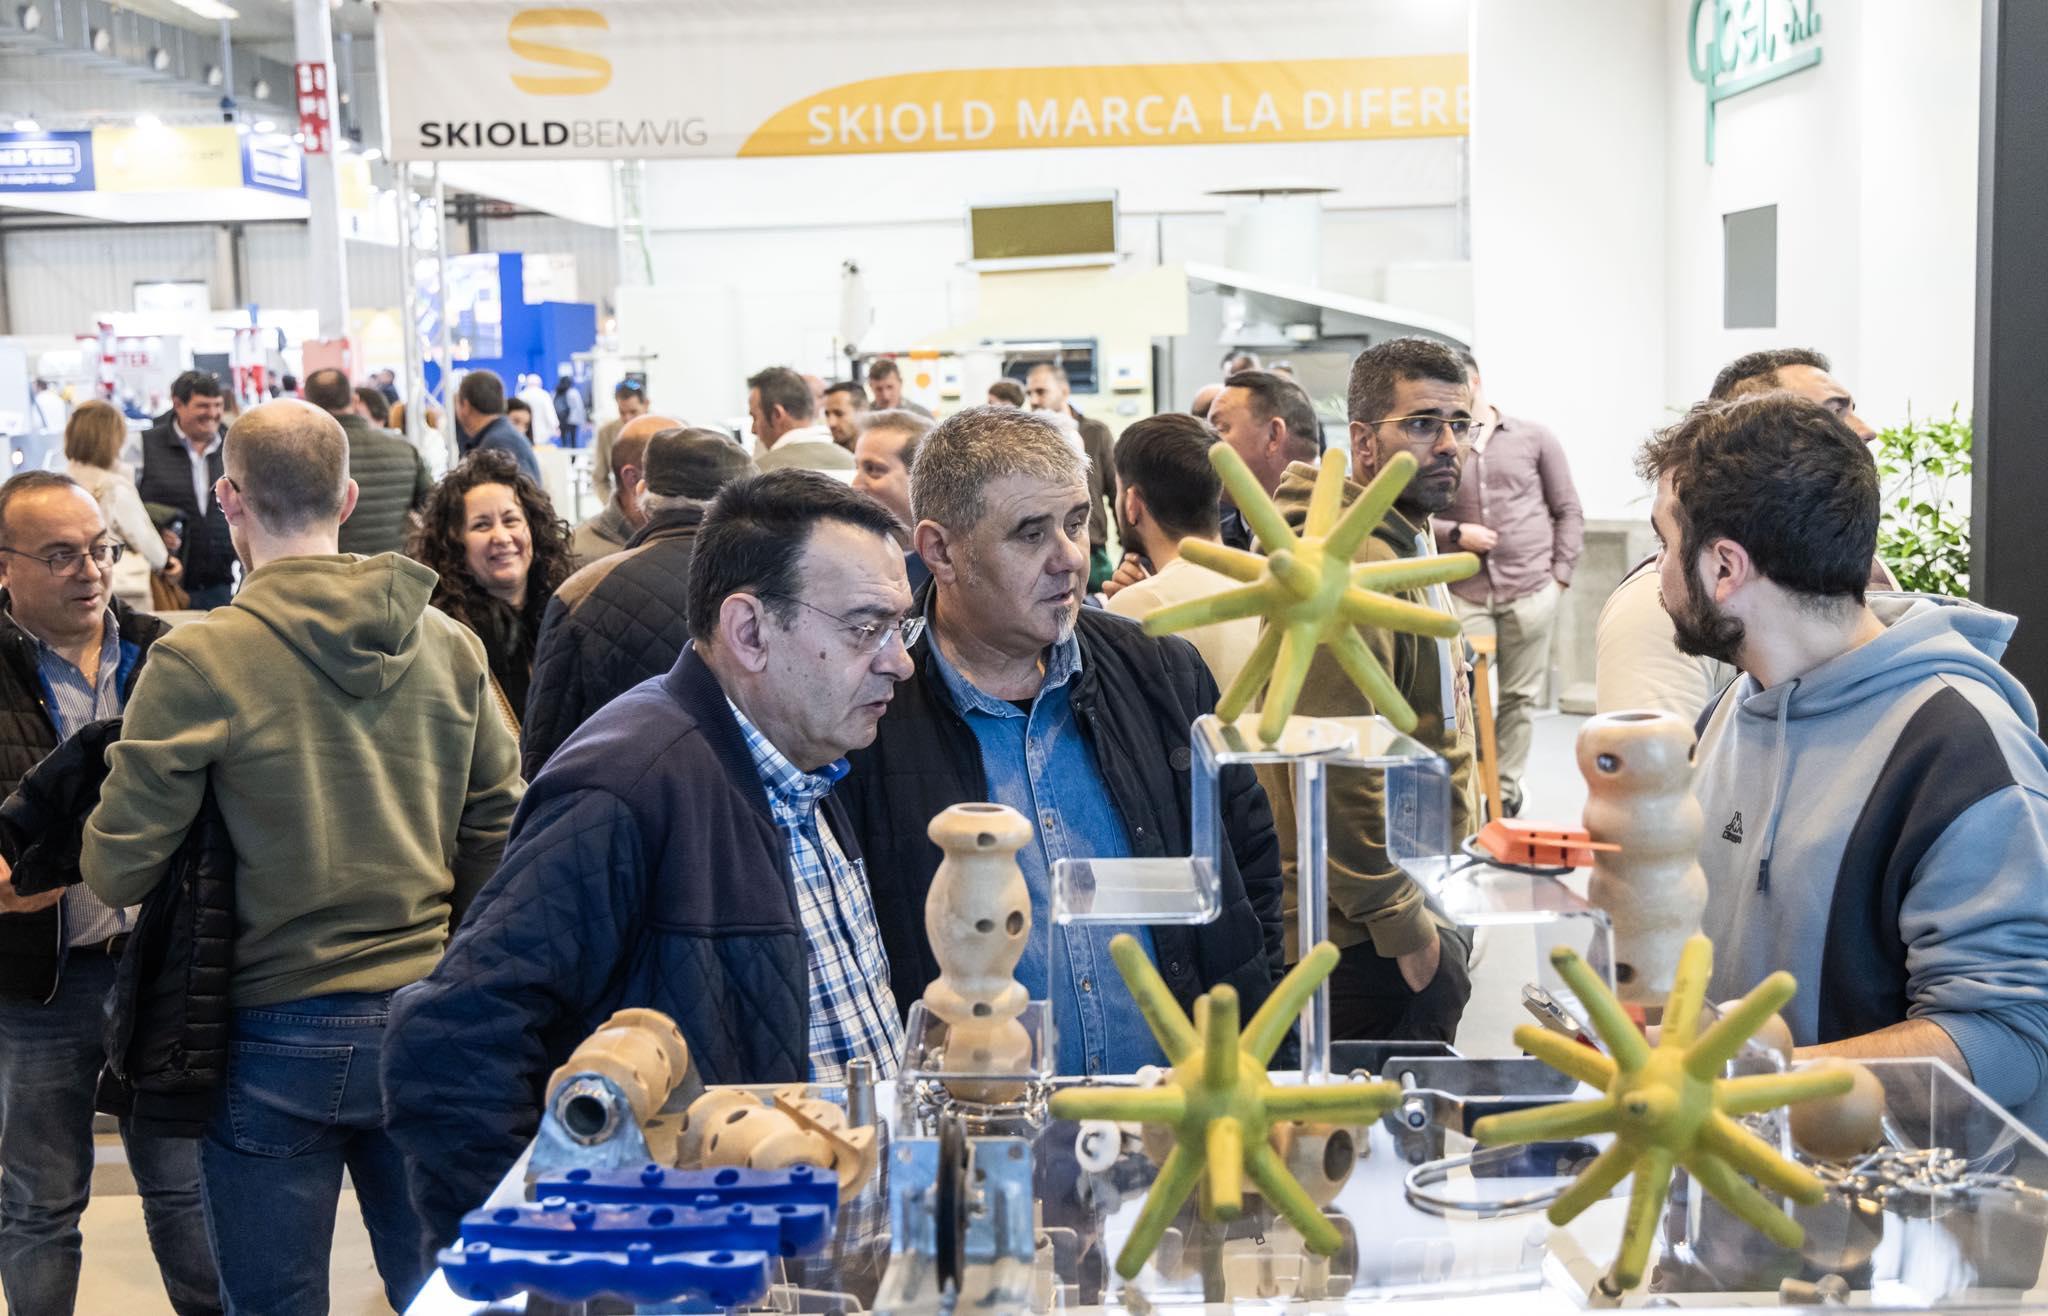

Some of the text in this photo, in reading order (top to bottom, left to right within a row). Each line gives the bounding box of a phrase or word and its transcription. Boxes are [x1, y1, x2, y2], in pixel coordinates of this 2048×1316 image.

[806, 101, 996, 146] SKIOLD
[1016, 94, 1204, 139] MARCA
[1221, 91, 1284, 134] LA
